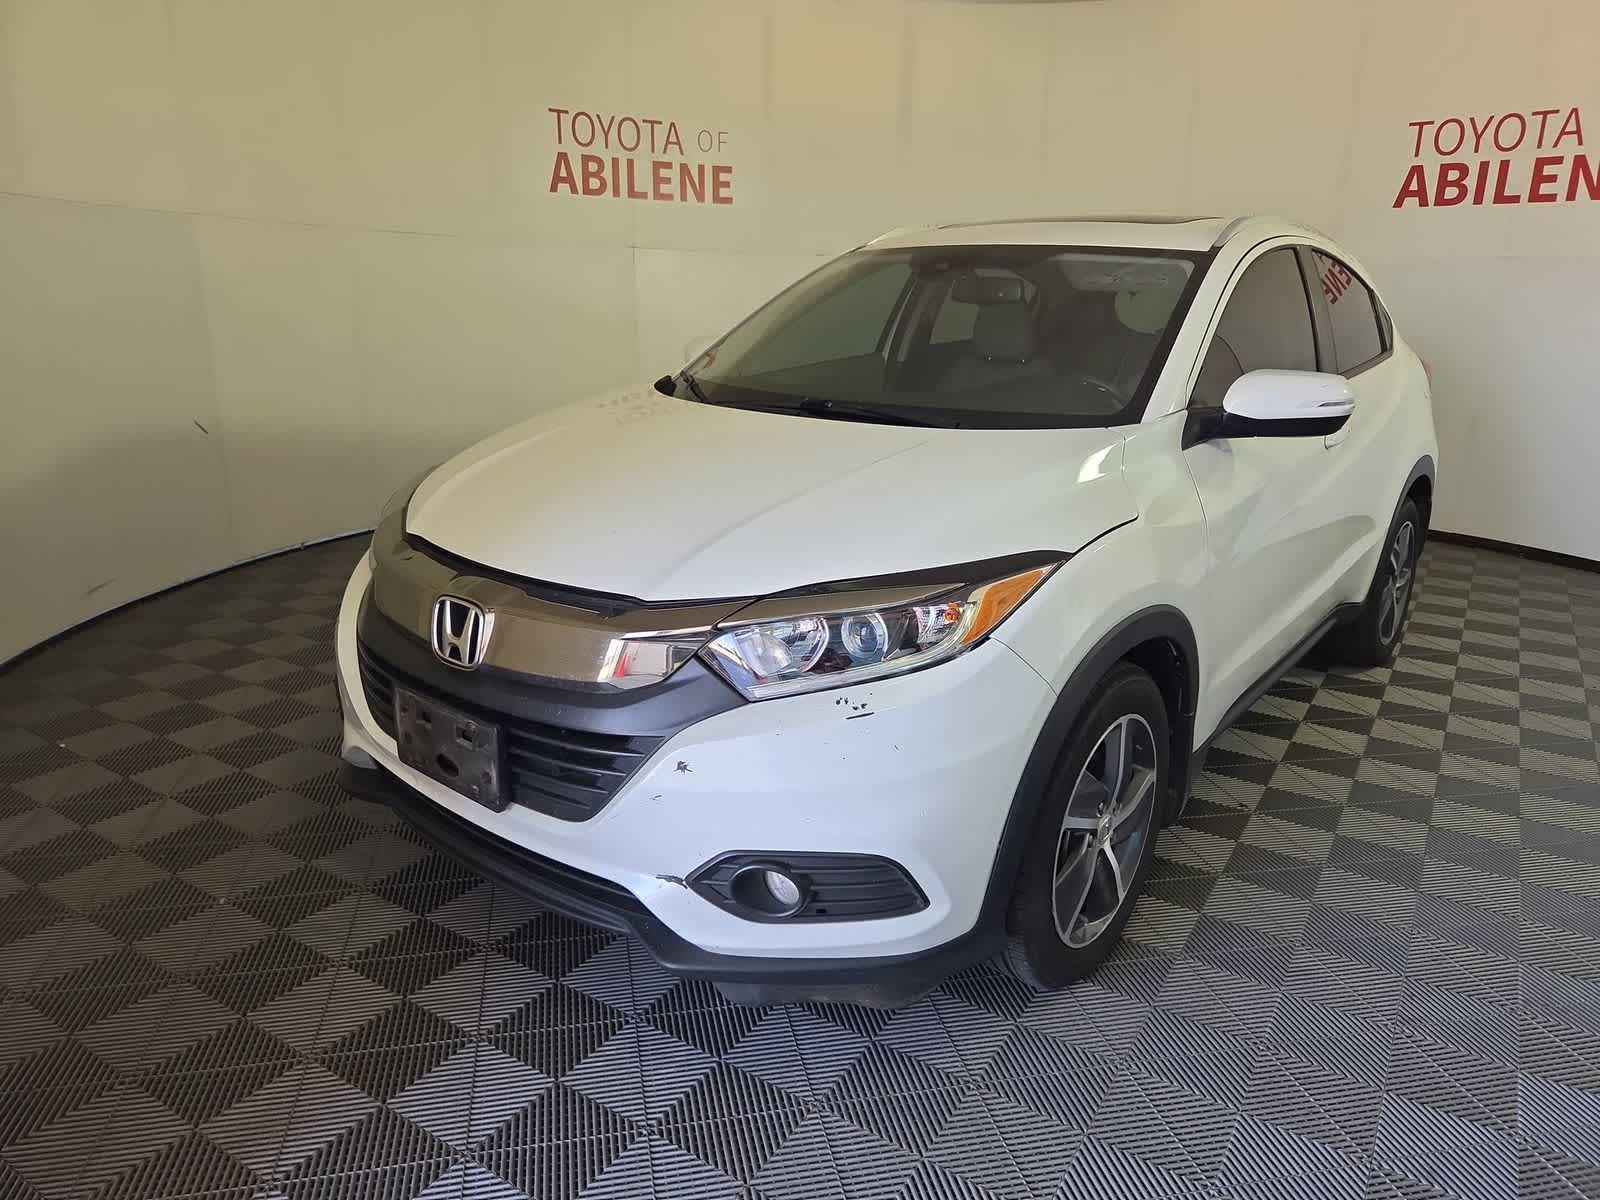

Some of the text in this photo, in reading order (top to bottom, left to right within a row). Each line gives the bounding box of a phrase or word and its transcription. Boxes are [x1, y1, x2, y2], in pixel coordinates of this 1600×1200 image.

[548, 107, 729, 156] TOYOTA OF
[1408, 107, 1584, 158] TOYOTA
[549, 151, 734, 205] ABILENE
[1392, 153, 1600, 208] ABILEN
